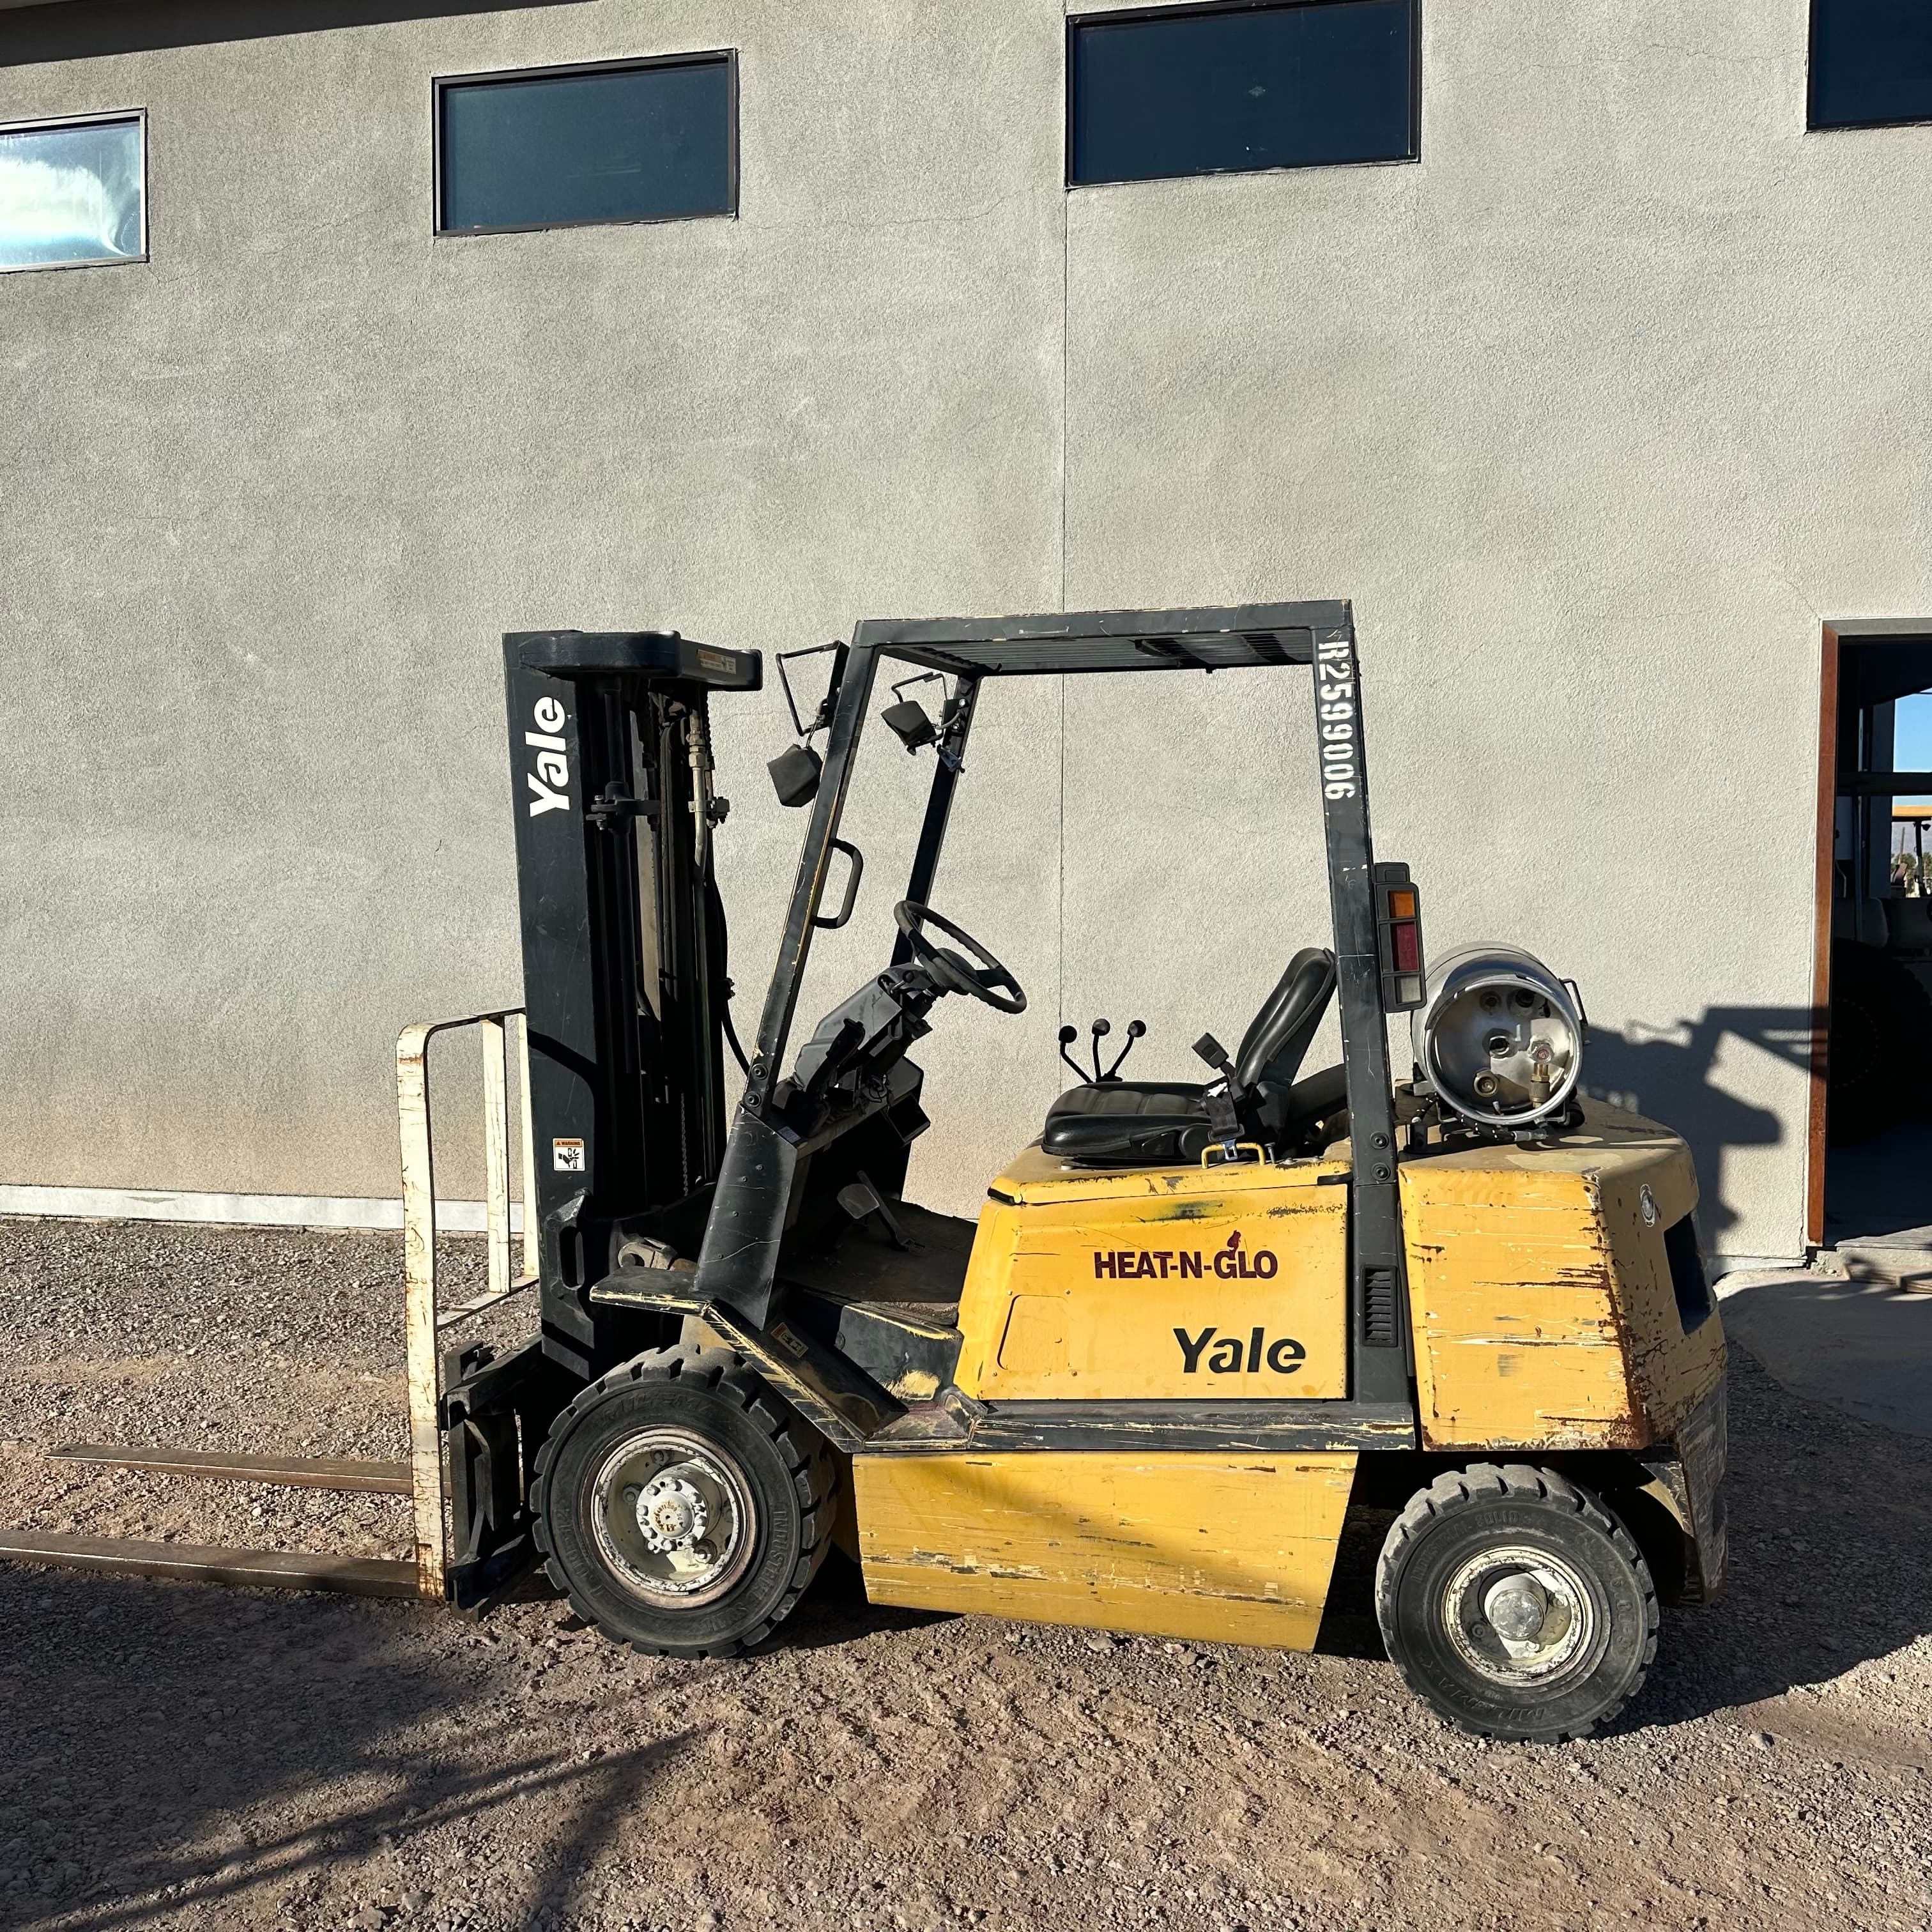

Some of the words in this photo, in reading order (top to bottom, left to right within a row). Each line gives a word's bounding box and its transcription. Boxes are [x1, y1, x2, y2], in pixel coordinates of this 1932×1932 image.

[525, 695, 570, 818] Yale
[1318, 641, 1355, 800] R2599006
[1094, 1250, 1278, 1279] HEAT-N-GLO
[1173, 1327, 1306, 1374] Yale
